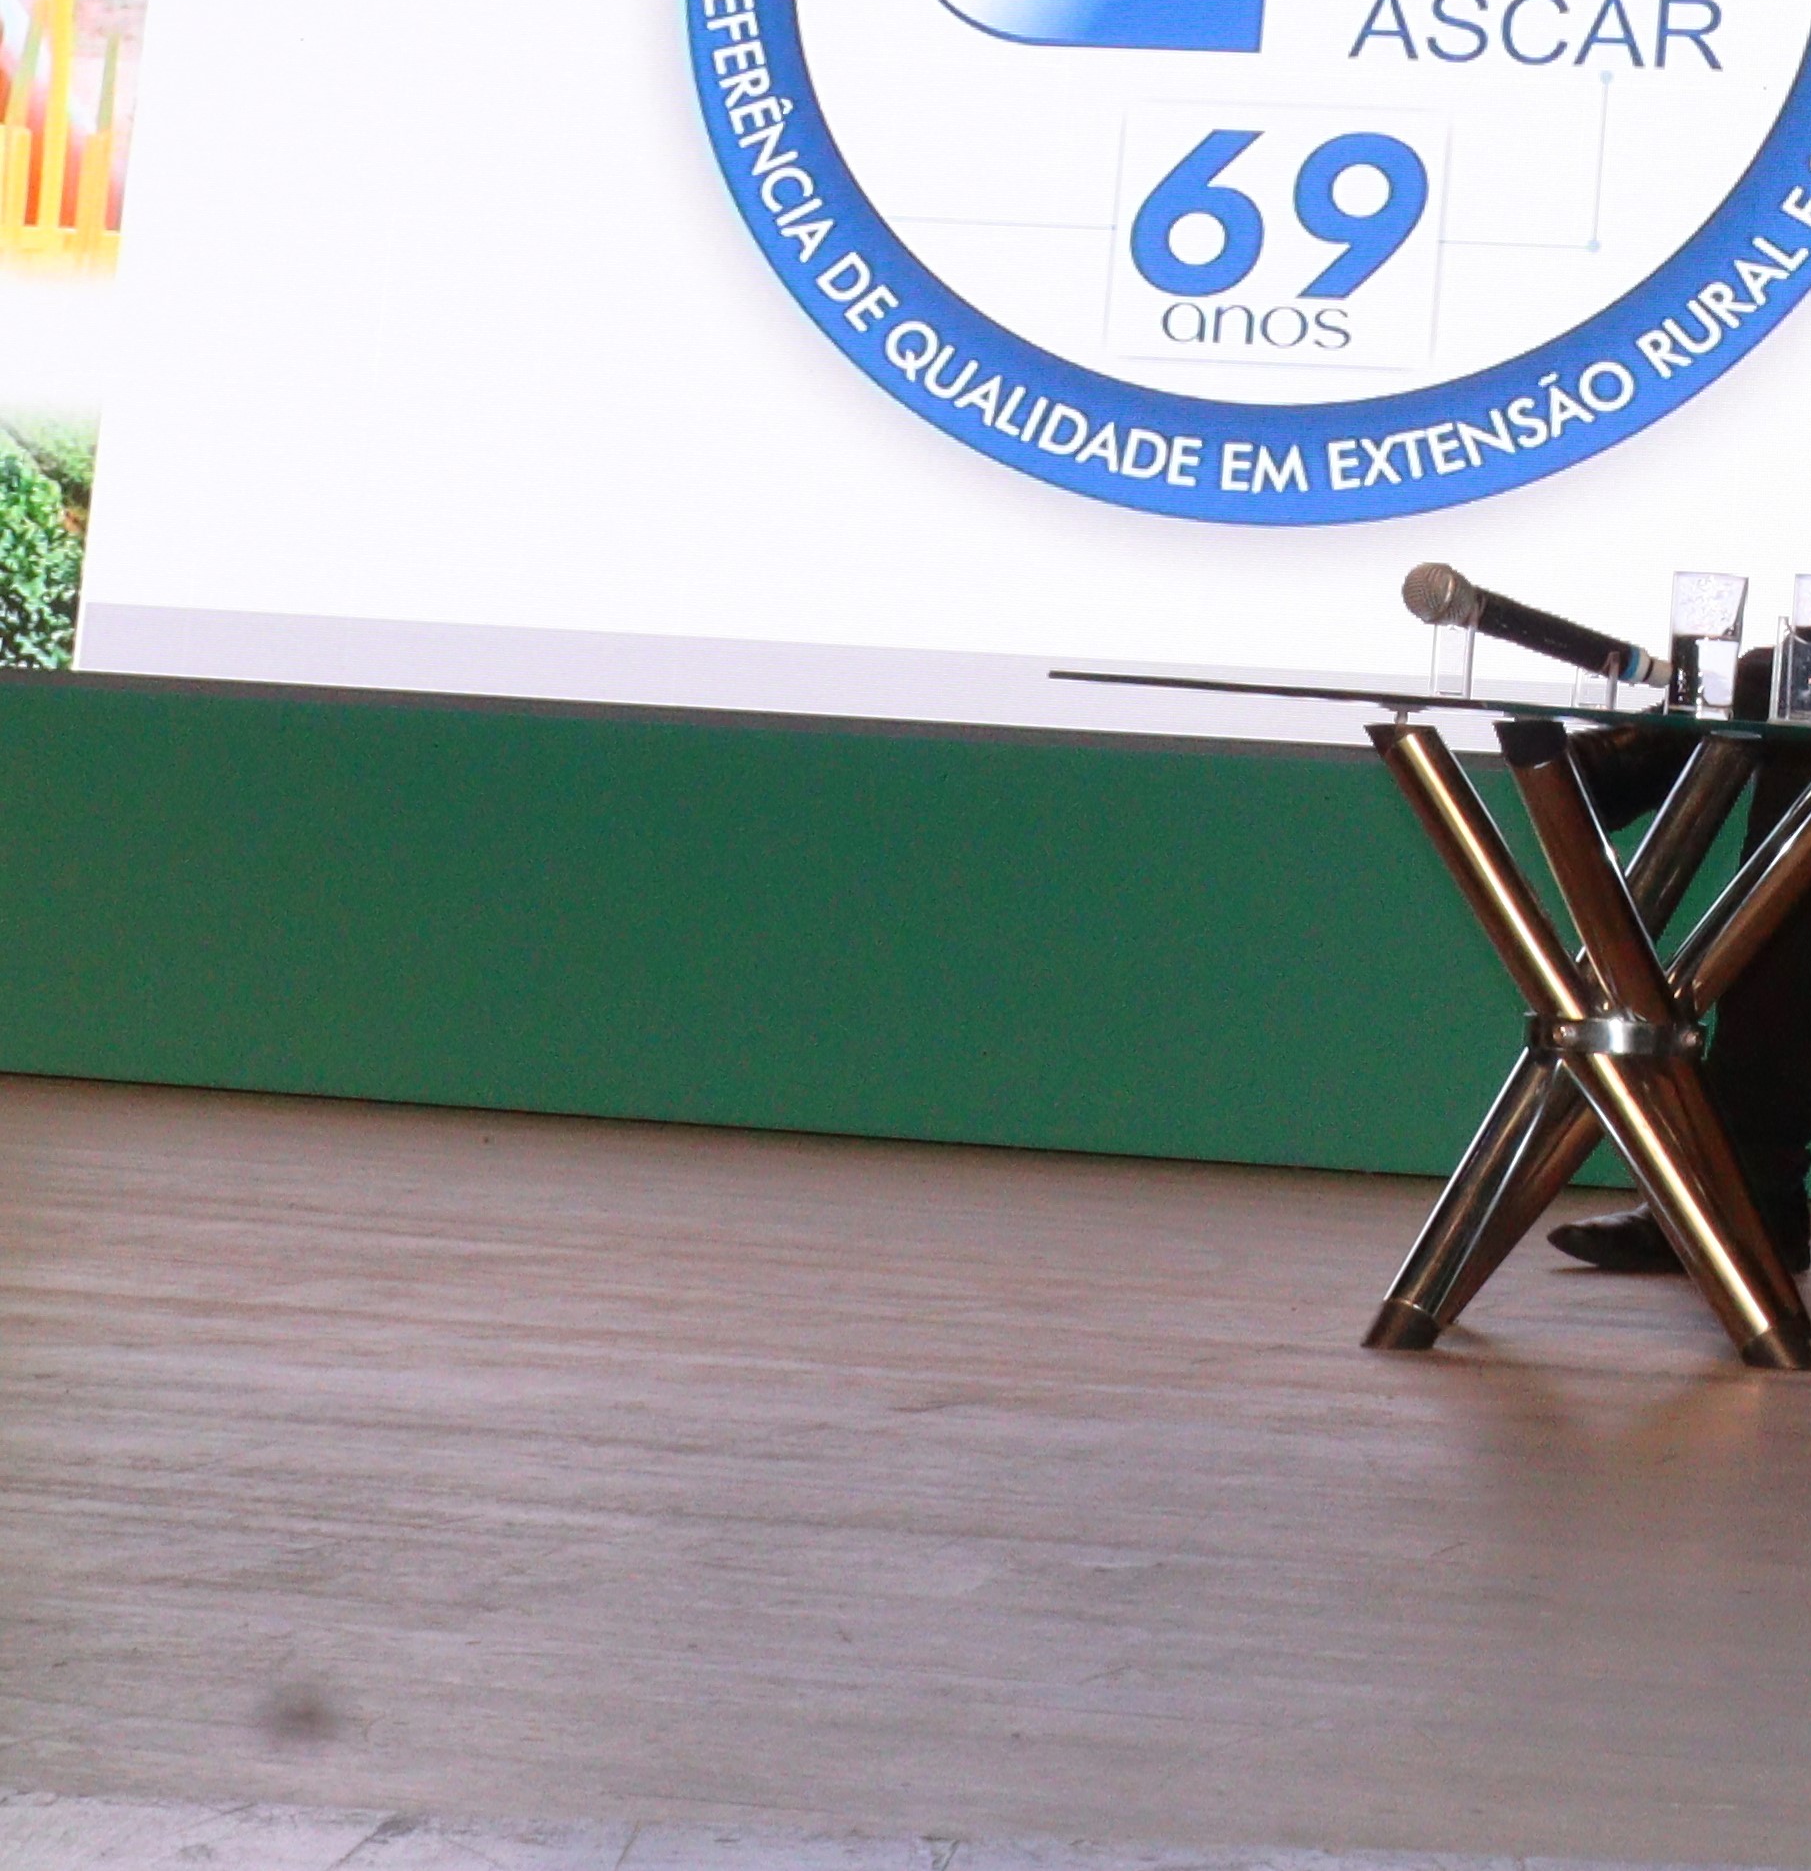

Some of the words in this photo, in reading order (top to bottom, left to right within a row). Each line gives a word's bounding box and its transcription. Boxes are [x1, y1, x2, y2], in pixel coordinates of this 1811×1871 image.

[1130, 129, 1429, 299] 69
[815, 252, 898, 332] DE
[884, 321, 1203, 487] QUALIDADE
[1221, 442, 1308, 493] EM
[1327, 360, 1636, 490] EXTENSÃO
[1637, 237, 1808, 379] RURAL
[1162, 302, 1352, 349] anos
